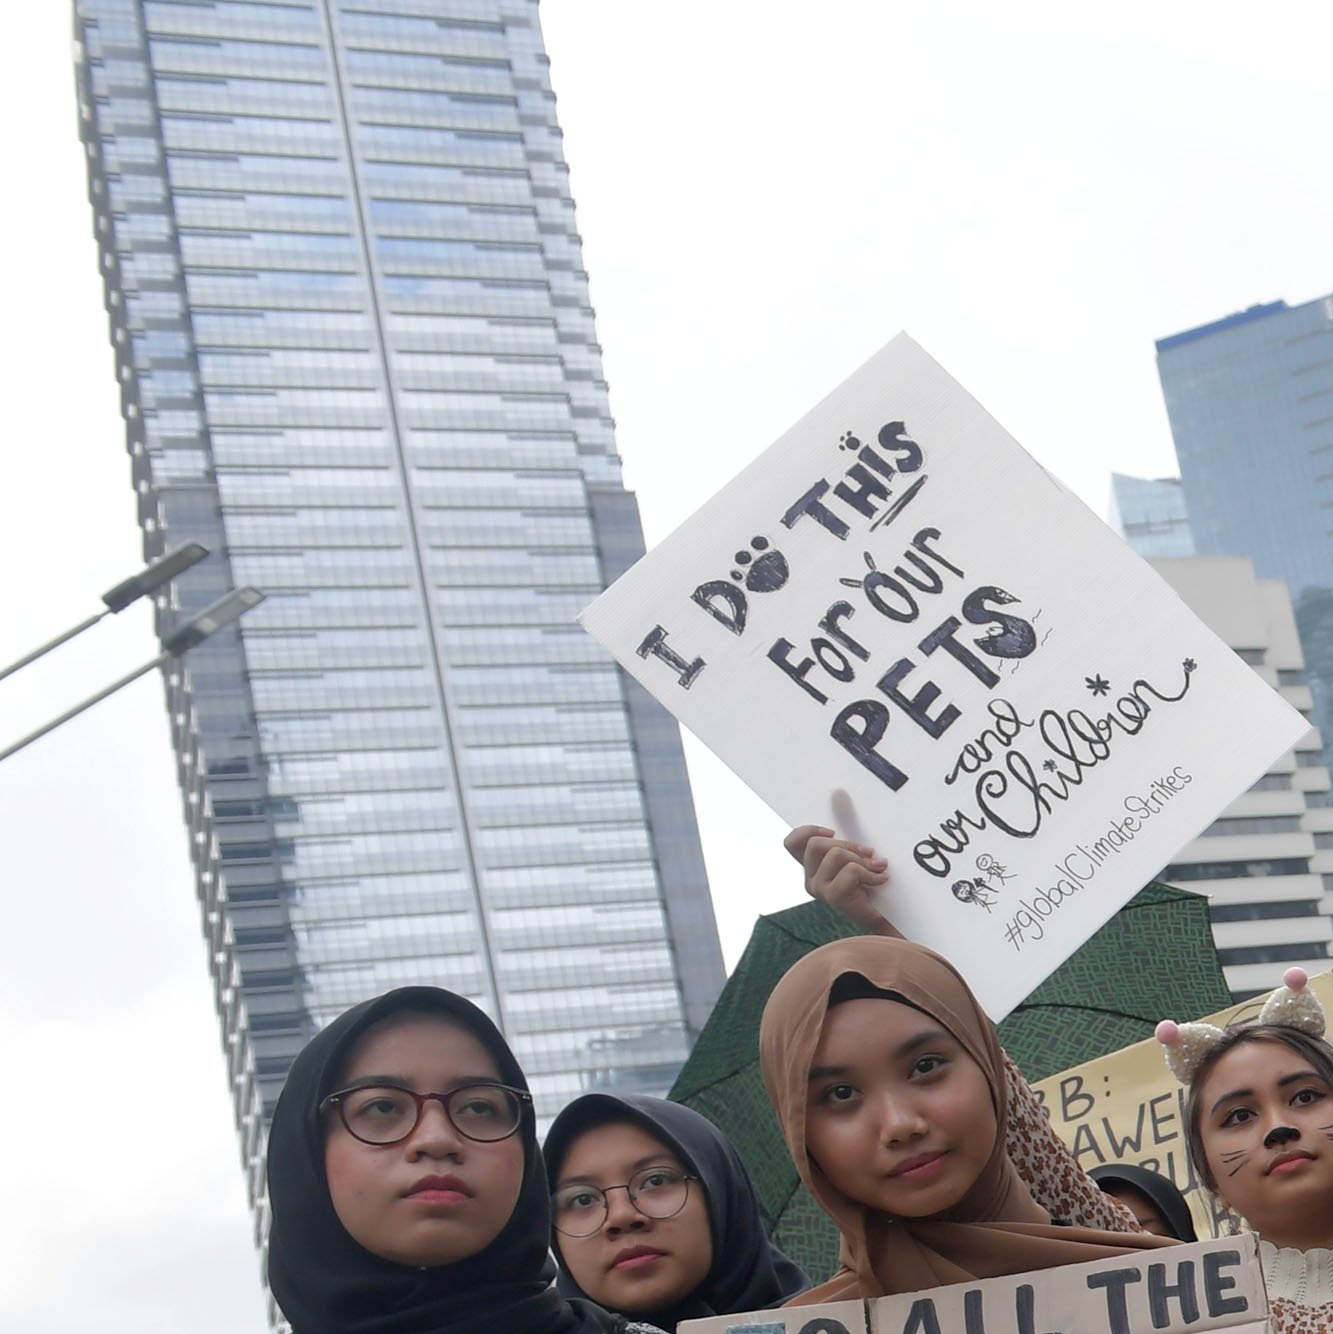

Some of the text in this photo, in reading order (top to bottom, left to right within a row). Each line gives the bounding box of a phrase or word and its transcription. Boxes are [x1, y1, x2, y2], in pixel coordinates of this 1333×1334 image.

[636, 624, 707, 690] I
[830, 585, 1037, 792] PETS
[945, 698, 1034, 785] and
[913, 658, 1198, 878] our Children
[1004, 767, 1193, 951] #globalClimateStrikes
